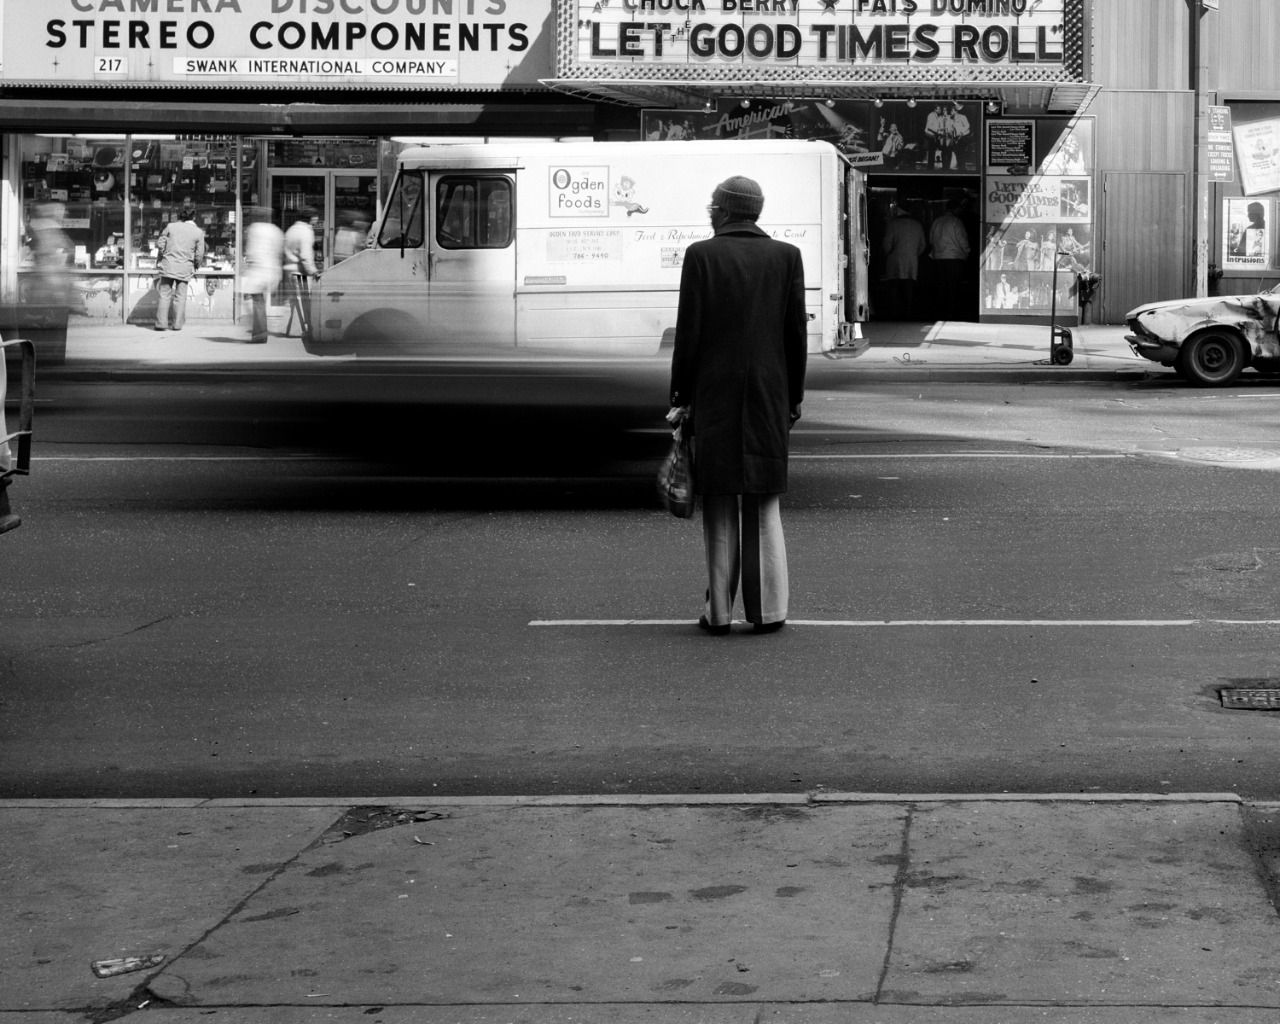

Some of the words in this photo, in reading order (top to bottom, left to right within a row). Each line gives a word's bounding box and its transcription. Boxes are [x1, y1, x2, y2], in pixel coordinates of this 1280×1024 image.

[46, 19, 216, 50] STEREO
[249, 20, 531, 53] COMPONENTS
[690, 22, 802, 59] GOOD
[811, 23, 940, 60] TIMES
[98, 58, 122, 74] 217
[186, 59, 239, 74] SWANK
[248, 59, 363, 75] INTERNATIONAL
[371, 60, 446, 76] COMPANY
[706, 103, 802, 136] American
[553, 169, 605, 194] Ogden
[558, 193, 601, 209] foods
